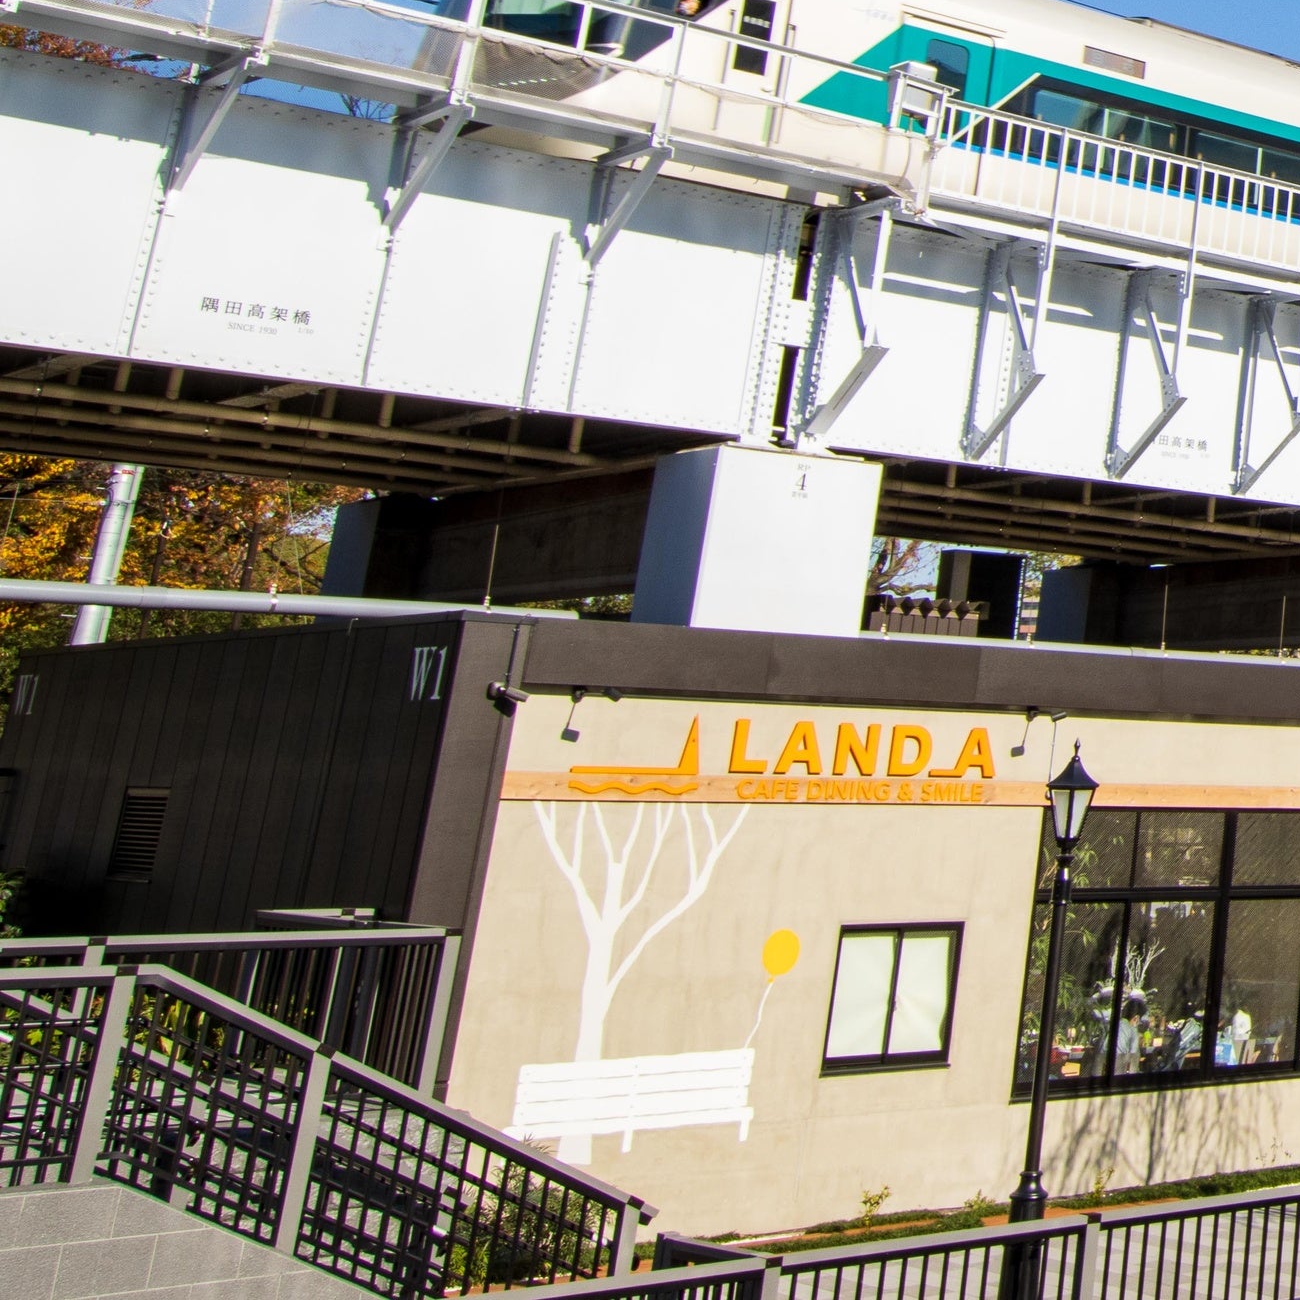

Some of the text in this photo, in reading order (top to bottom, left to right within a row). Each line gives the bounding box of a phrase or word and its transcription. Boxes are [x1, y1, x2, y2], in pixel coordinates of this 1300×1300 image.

[200, 296, 311, 326] 隅田高架橋
[227, 321, 256, 332] SINCE
[1152, 434, 1208, 452] 田高架橋
[795, 473, 808, 491] 4
[411, 646, 448, 701] W1
[14, 674, 40, 715] W1
[735, 779, 984, 803] CAFE DINING & SMILE
